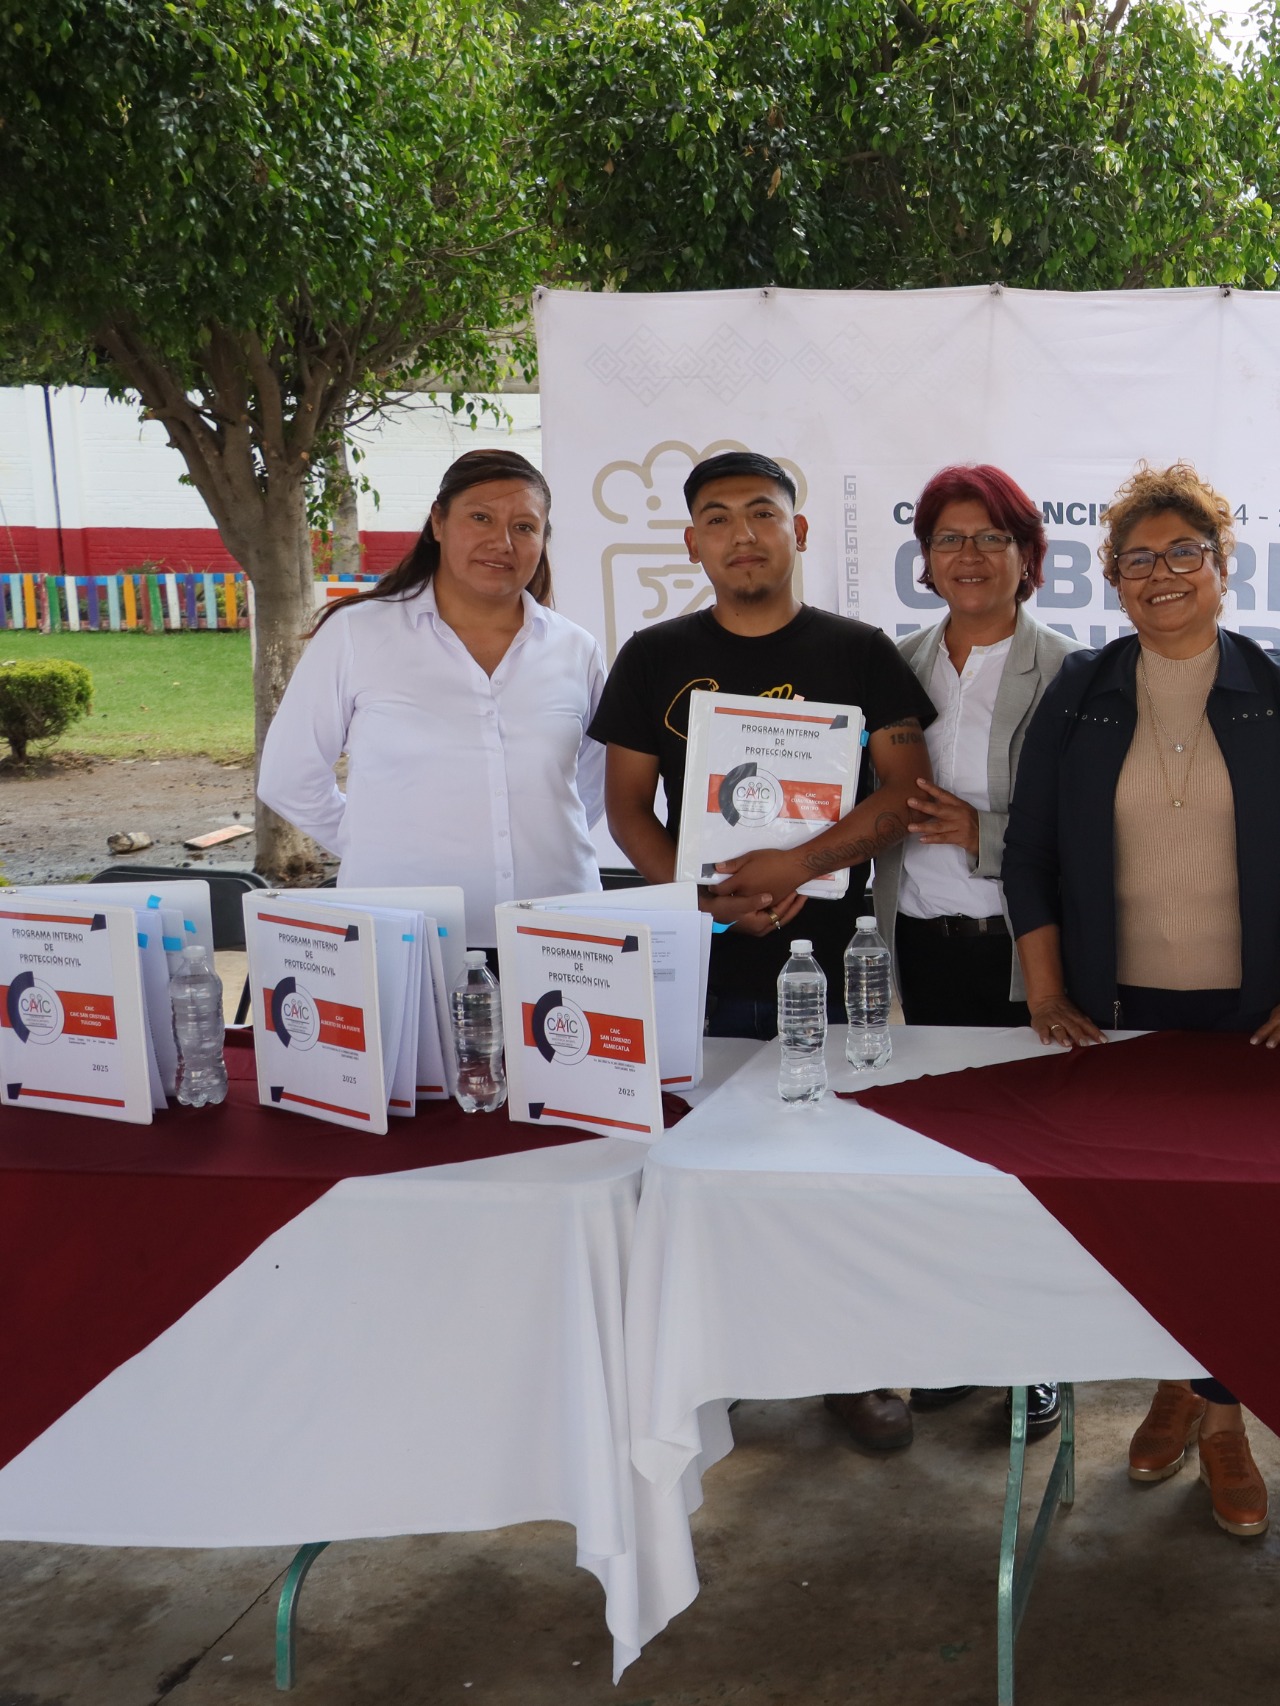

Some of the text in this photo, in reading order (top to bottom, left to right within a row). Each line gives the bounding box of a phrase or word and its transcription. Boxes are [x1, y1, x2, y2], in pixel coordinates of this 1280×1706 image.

[741, 724, 820, 738] PROGRAMA INTERNO
[775, 738, 785, 746] DE
[745, 746, 812, 759] PROTECCIÓN CIVIL
[736, 786, 770, 799] CAIC
[12, 928, 84, 941] PROGRAMA INTERNO
[44, 943, 54, 951] DE
[279, 933, 338, 951] PROGRAMA INTERNO
[20, 954, 81, 966] PROTECCIÓN CIVIL
[305, 950, 313, 959] DE
[542, 946, 613, 963] PROGRAMA INTERNO
[284, 959, 336, 976] PROTECCIÓN CIVIL
[574, 963, 584, 971] DE
[549, 972, 610, 988] PROTECCIÓN CIVIL
[21, 998, 51, 1013] CAIC
[283, 1003, 309, 1020] CAIC
[547, 1018, 578, 1034] CAIC
[92, 1064, 109, 1072] 2025
[342, 1075, 356, 1084] 2025
[618, 1088, 635, 1097] 2025
